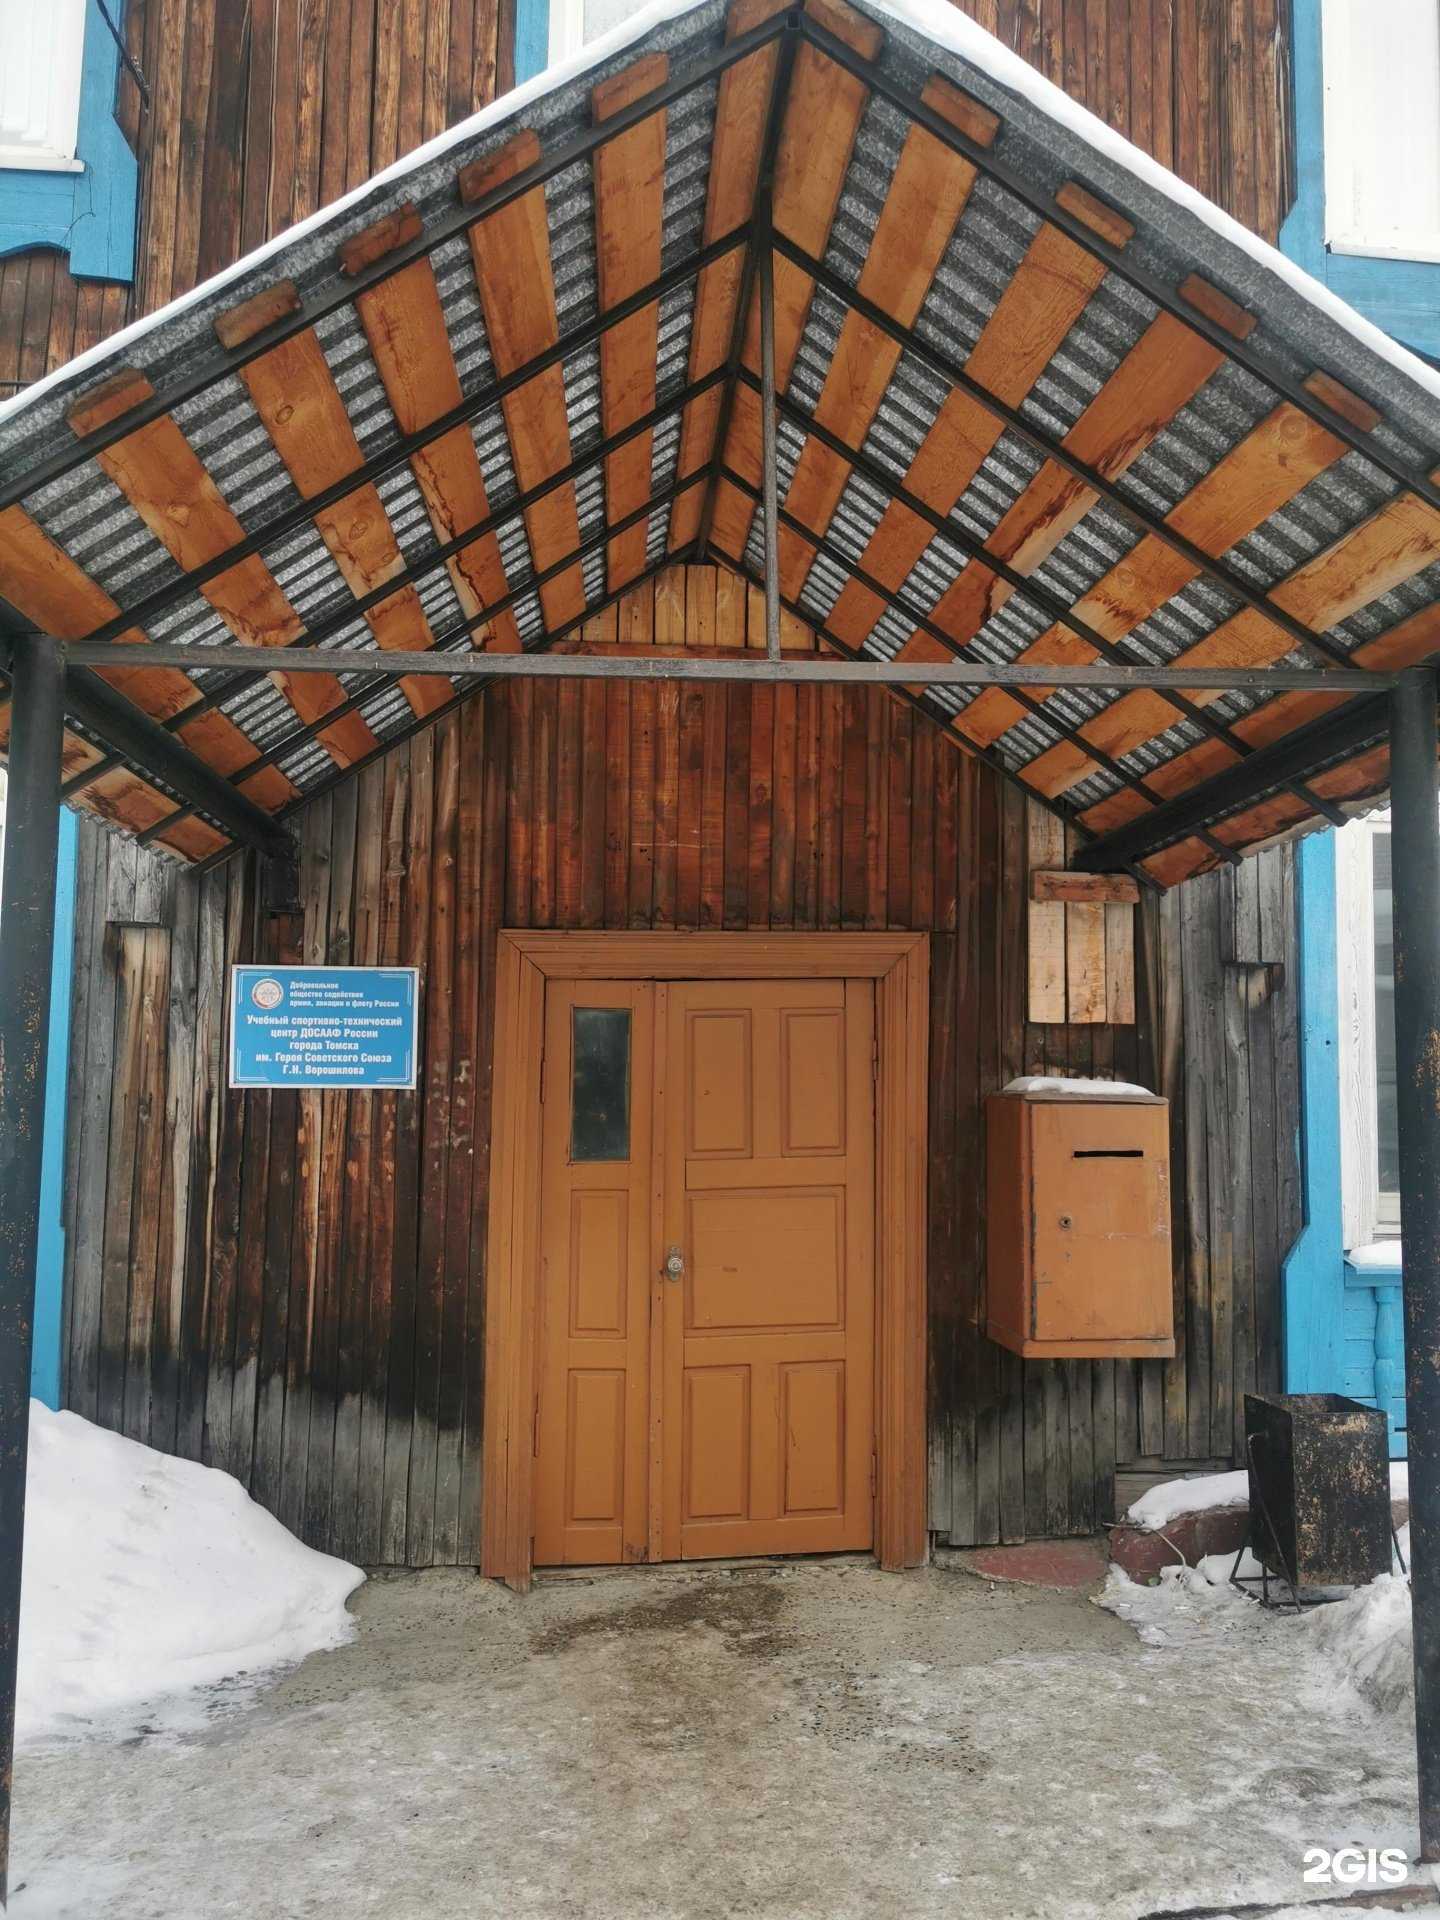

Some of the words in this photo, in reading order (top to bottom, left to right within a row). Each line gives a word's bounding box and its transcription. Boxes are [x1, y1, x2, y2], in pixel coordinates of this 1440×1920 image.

[374, 1000, 399, 1008] России
[247, 1014, 289, 1025] Учебный
[291, 1015, 403, 1027] спортивно-технический
[270, 1029, 298, 1038] центр
[300, 1028, 341, 1038] ДОСААФ
[344, 1028, 378, 1038] России
[289, 1041, 322, 1051] города
[325, 1040, 359, 1050] Томска
[256, 1054, 272, 1062] им.
[275, 1053, 302, 1063] Героя
[305, 1053, 358, 1062] Советского
[360, 1053, 392, 1063] Союза
[305, 1065, 365, 1076] Ворошилова
